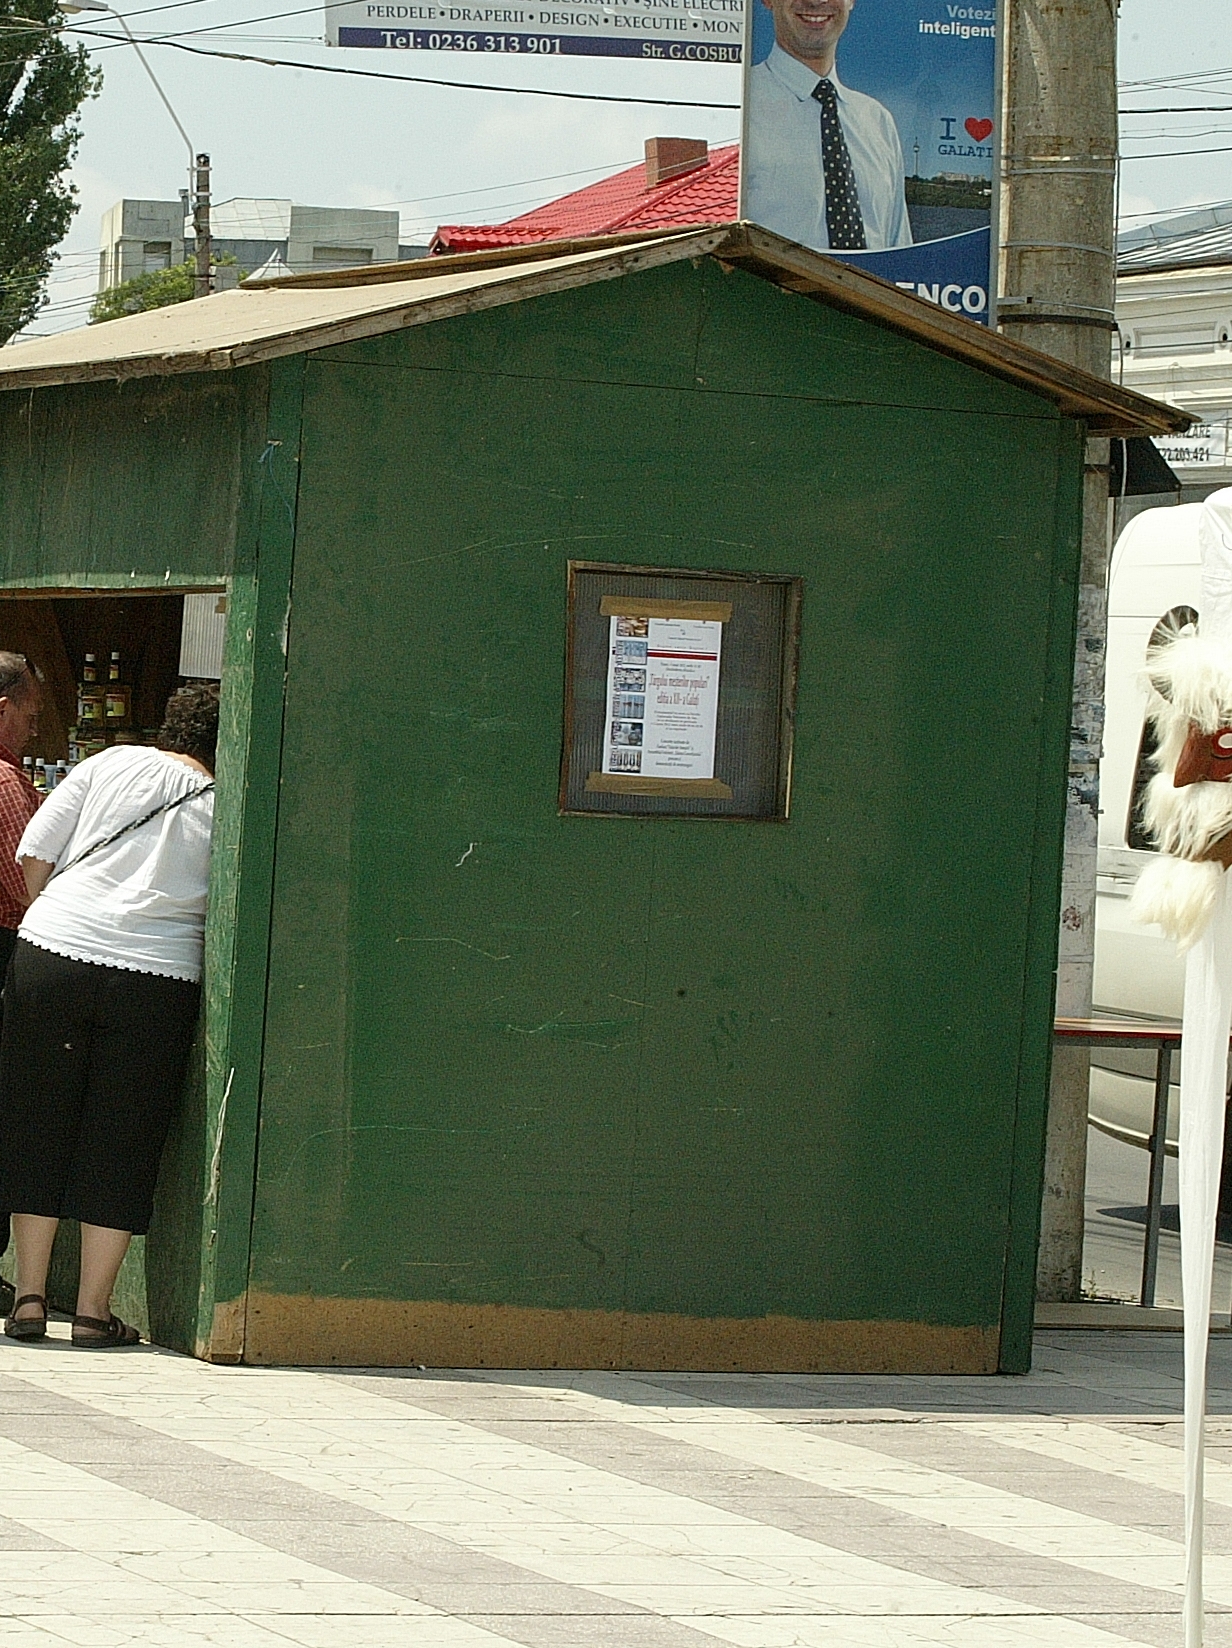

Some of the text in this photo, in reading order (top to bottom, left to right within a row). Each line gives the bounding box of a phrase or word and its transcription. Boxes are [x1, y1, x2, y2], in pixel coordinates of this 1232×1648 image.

[367, 5, 437, 20] PERDELE
[450, 8, 525, 22] DRAPERII
[539, 11, 599, 27] DESIGN
[614, 15, 688, 31] EXECUTIE
[918, 19, 996, 39] inteligent
[380, 31, 563, 55] Tel: 0236 313 901
[642, 42, 666, 58] Str.
[939, 117, 956, 140] I
